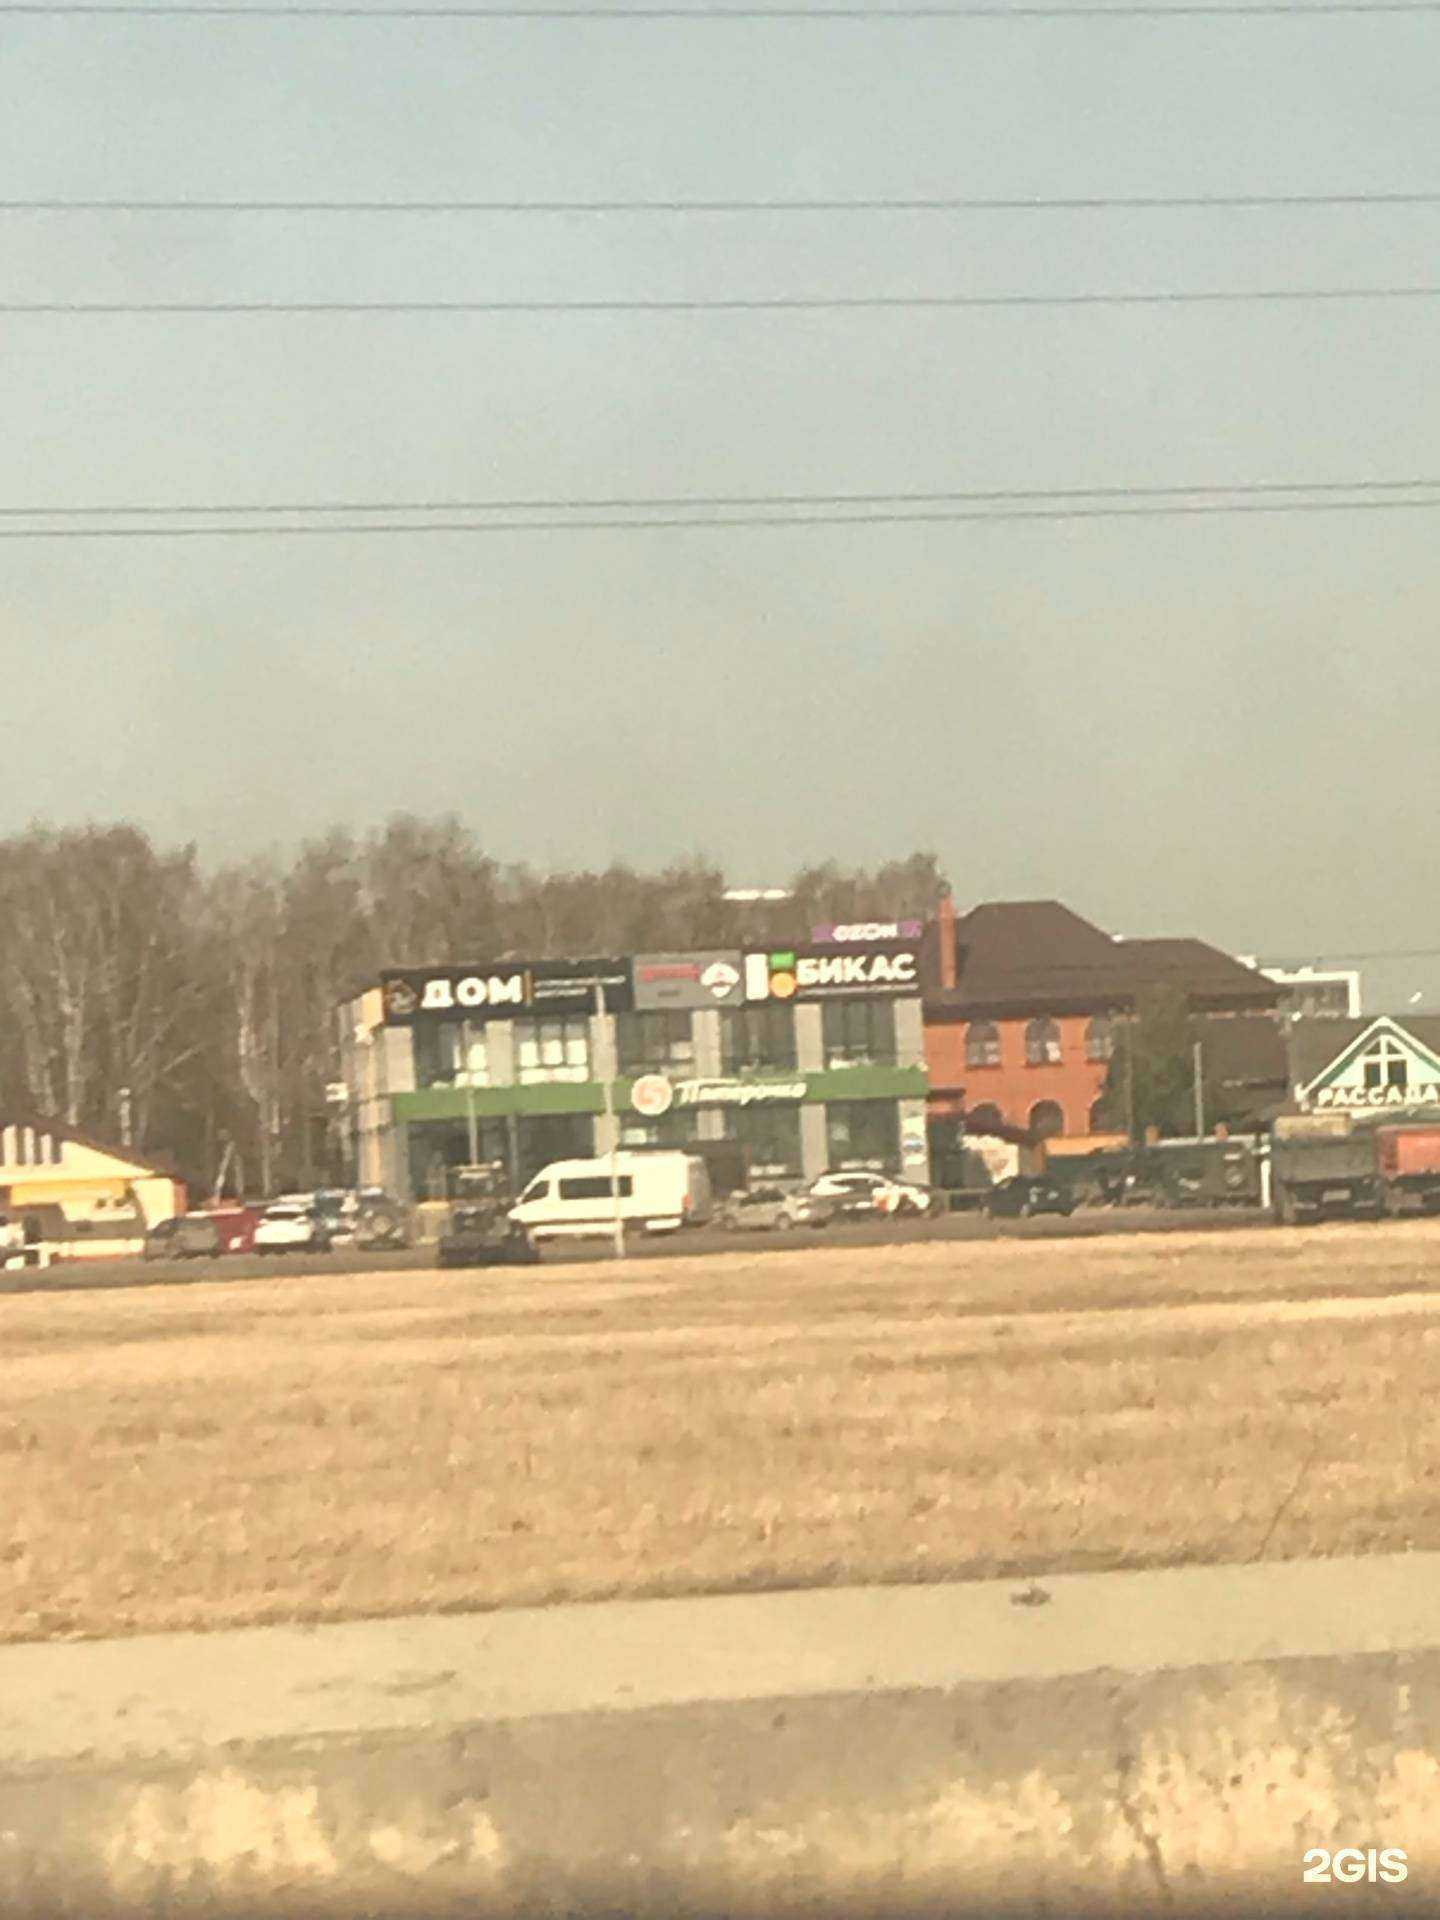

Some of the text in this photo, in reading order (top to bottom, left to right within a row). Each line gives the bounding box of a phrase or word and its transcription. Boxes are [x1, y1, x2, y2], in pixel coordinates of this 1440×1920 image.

[797, 954, 916, 985] БИКАС
[421, 975, 522, 1008] ДОМ
[1318, 1084, 1439, 1106] РАССАДА
